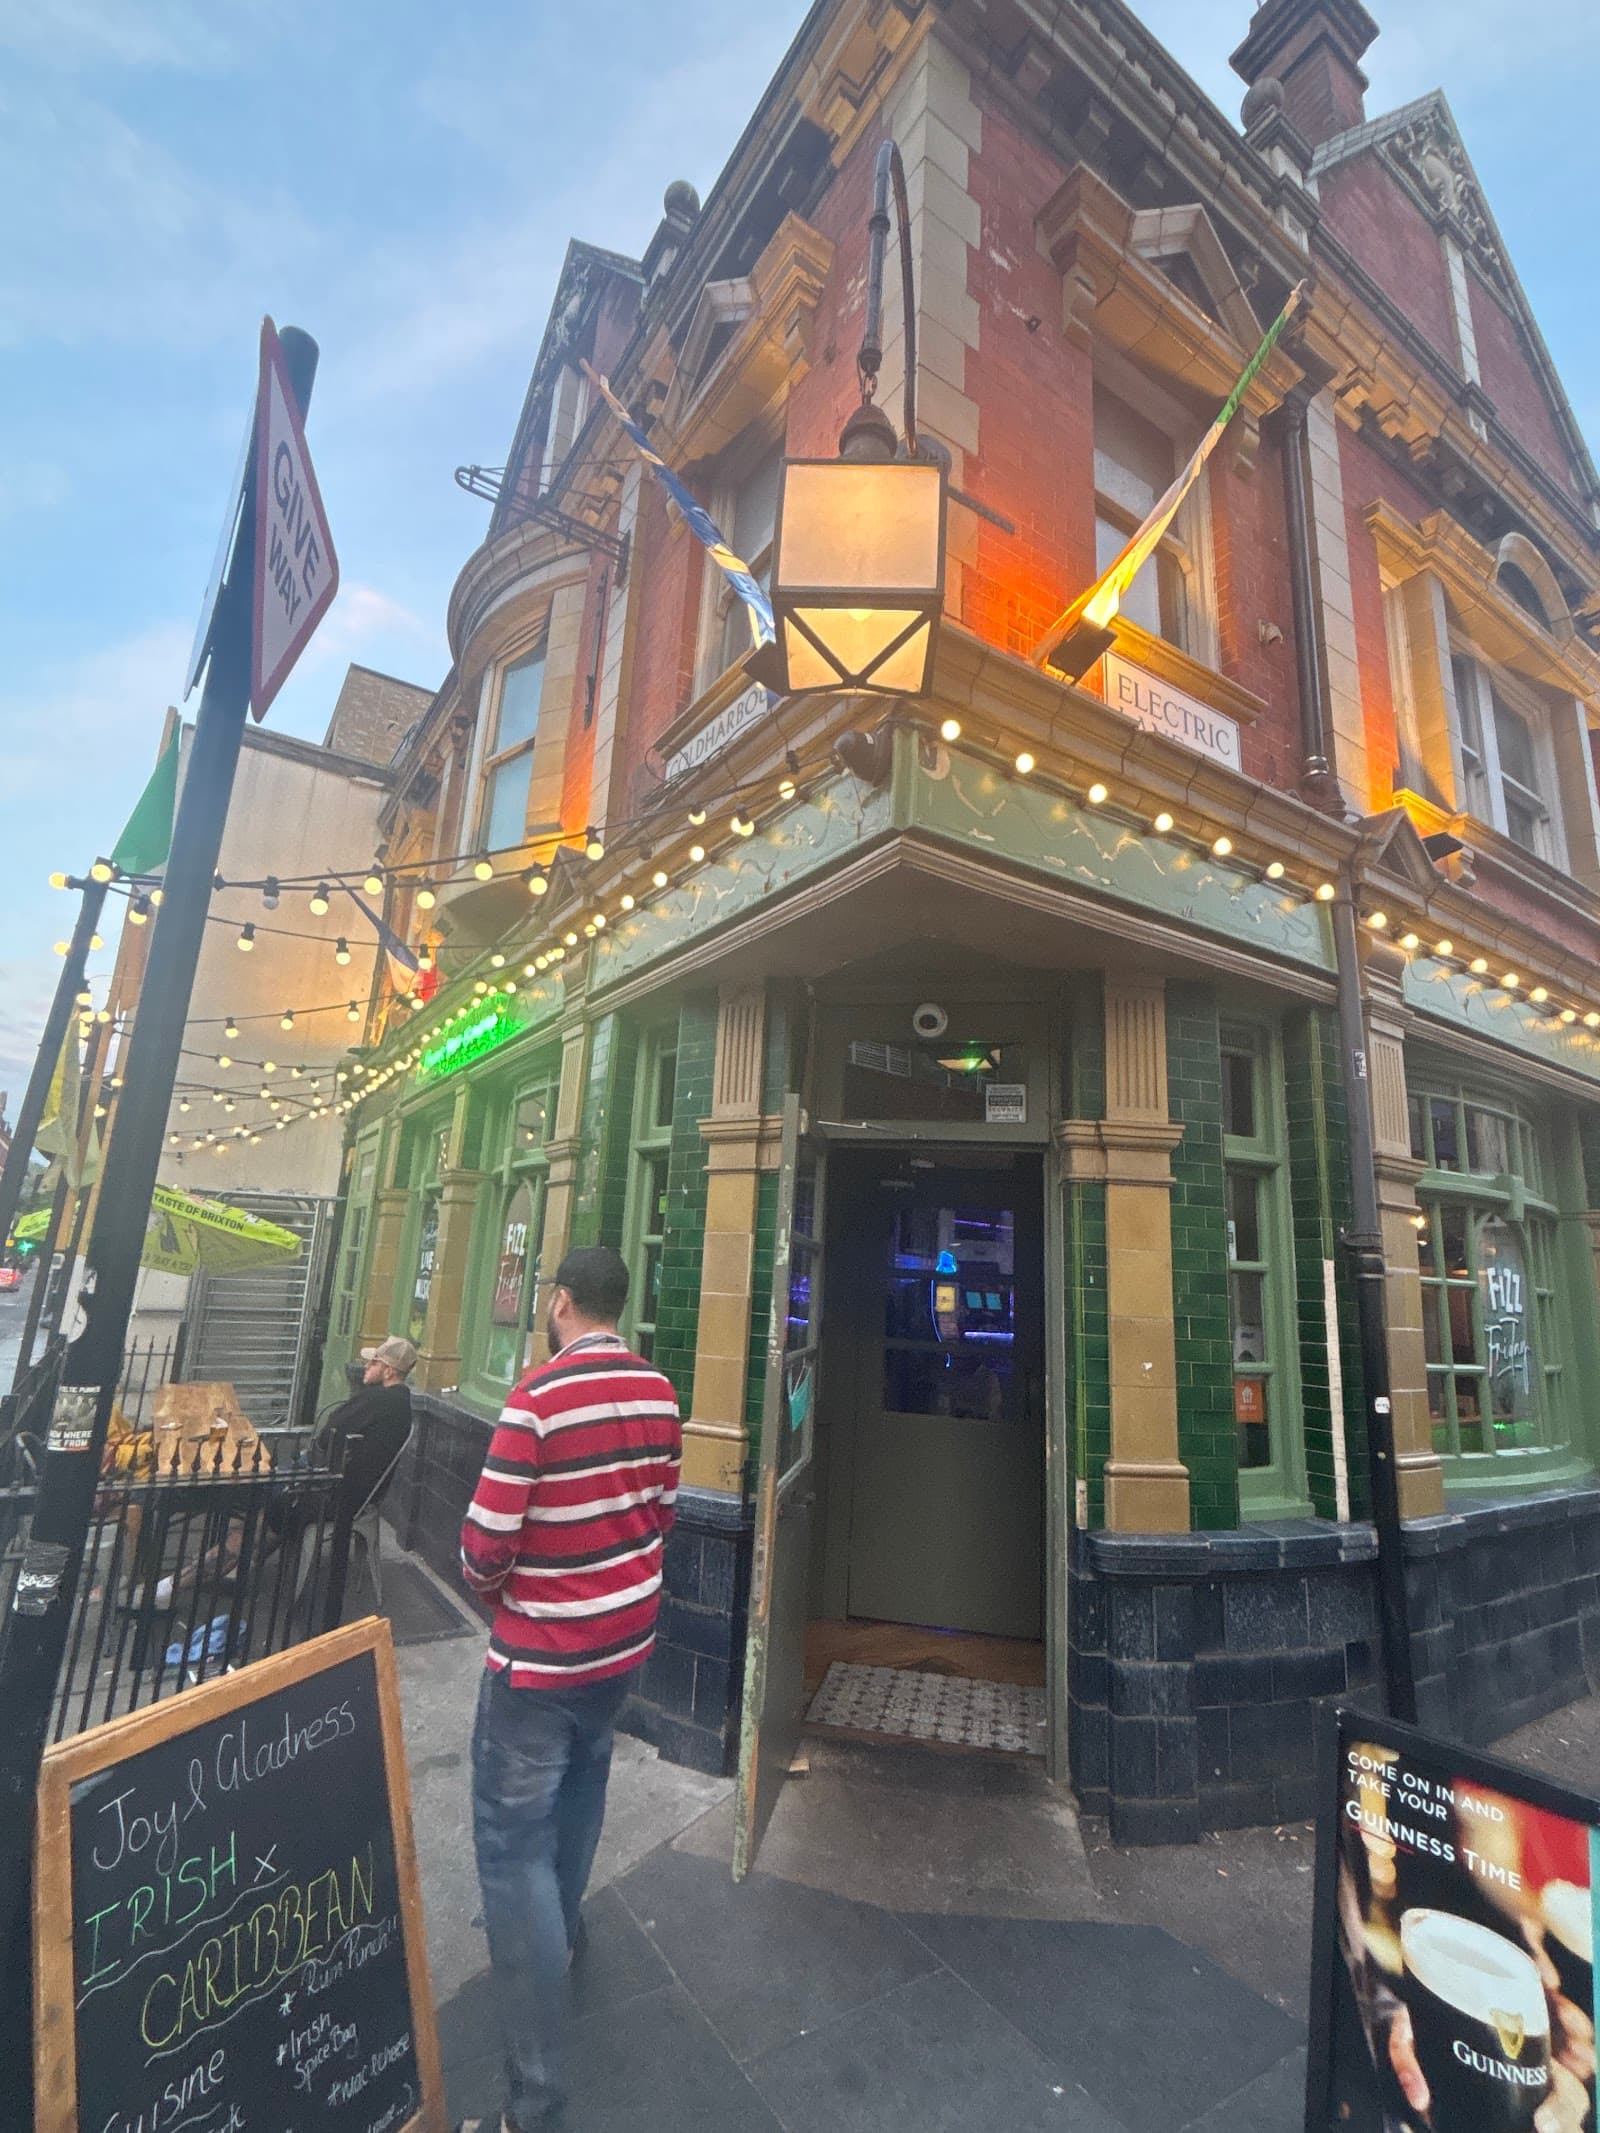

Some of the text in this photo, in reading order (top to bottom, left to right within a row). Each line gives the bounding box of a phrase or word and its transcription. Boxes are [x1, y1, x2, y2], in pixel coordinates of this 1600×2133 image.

[273, 439, 321, 601] GIVE
[269, 522, 302, 625] WAY
[1118, 673, 1231, 756] ELECTRIC
[185, 1204, 200, 1217] OF
[200, 1211, 245, 1232] BRIXTON
[1487, 1267, 1523, 1313] FIZZ
[63, 1430, 93, 1439] WHERE
[63, 1439, 88, 1448] FROM
[93, 1787, 178, 1876] Joy
[216, 1700, 355, 1791] Gladness
[1347, 1751, 1504, 1823] COME ON IN AND
[1347, 1768, 1448, 1821] TAKE YOUR
[1345, 1799, 1522, 1892] GUINNESS TIME
[82, 1830, 236, 1986] IRISH
[141, 1840, 374, 2047] CARIBBEAN
[290, 2013, 331, 2059] Irish
[1452, 2038, 1547, 2087] GUINNESS
